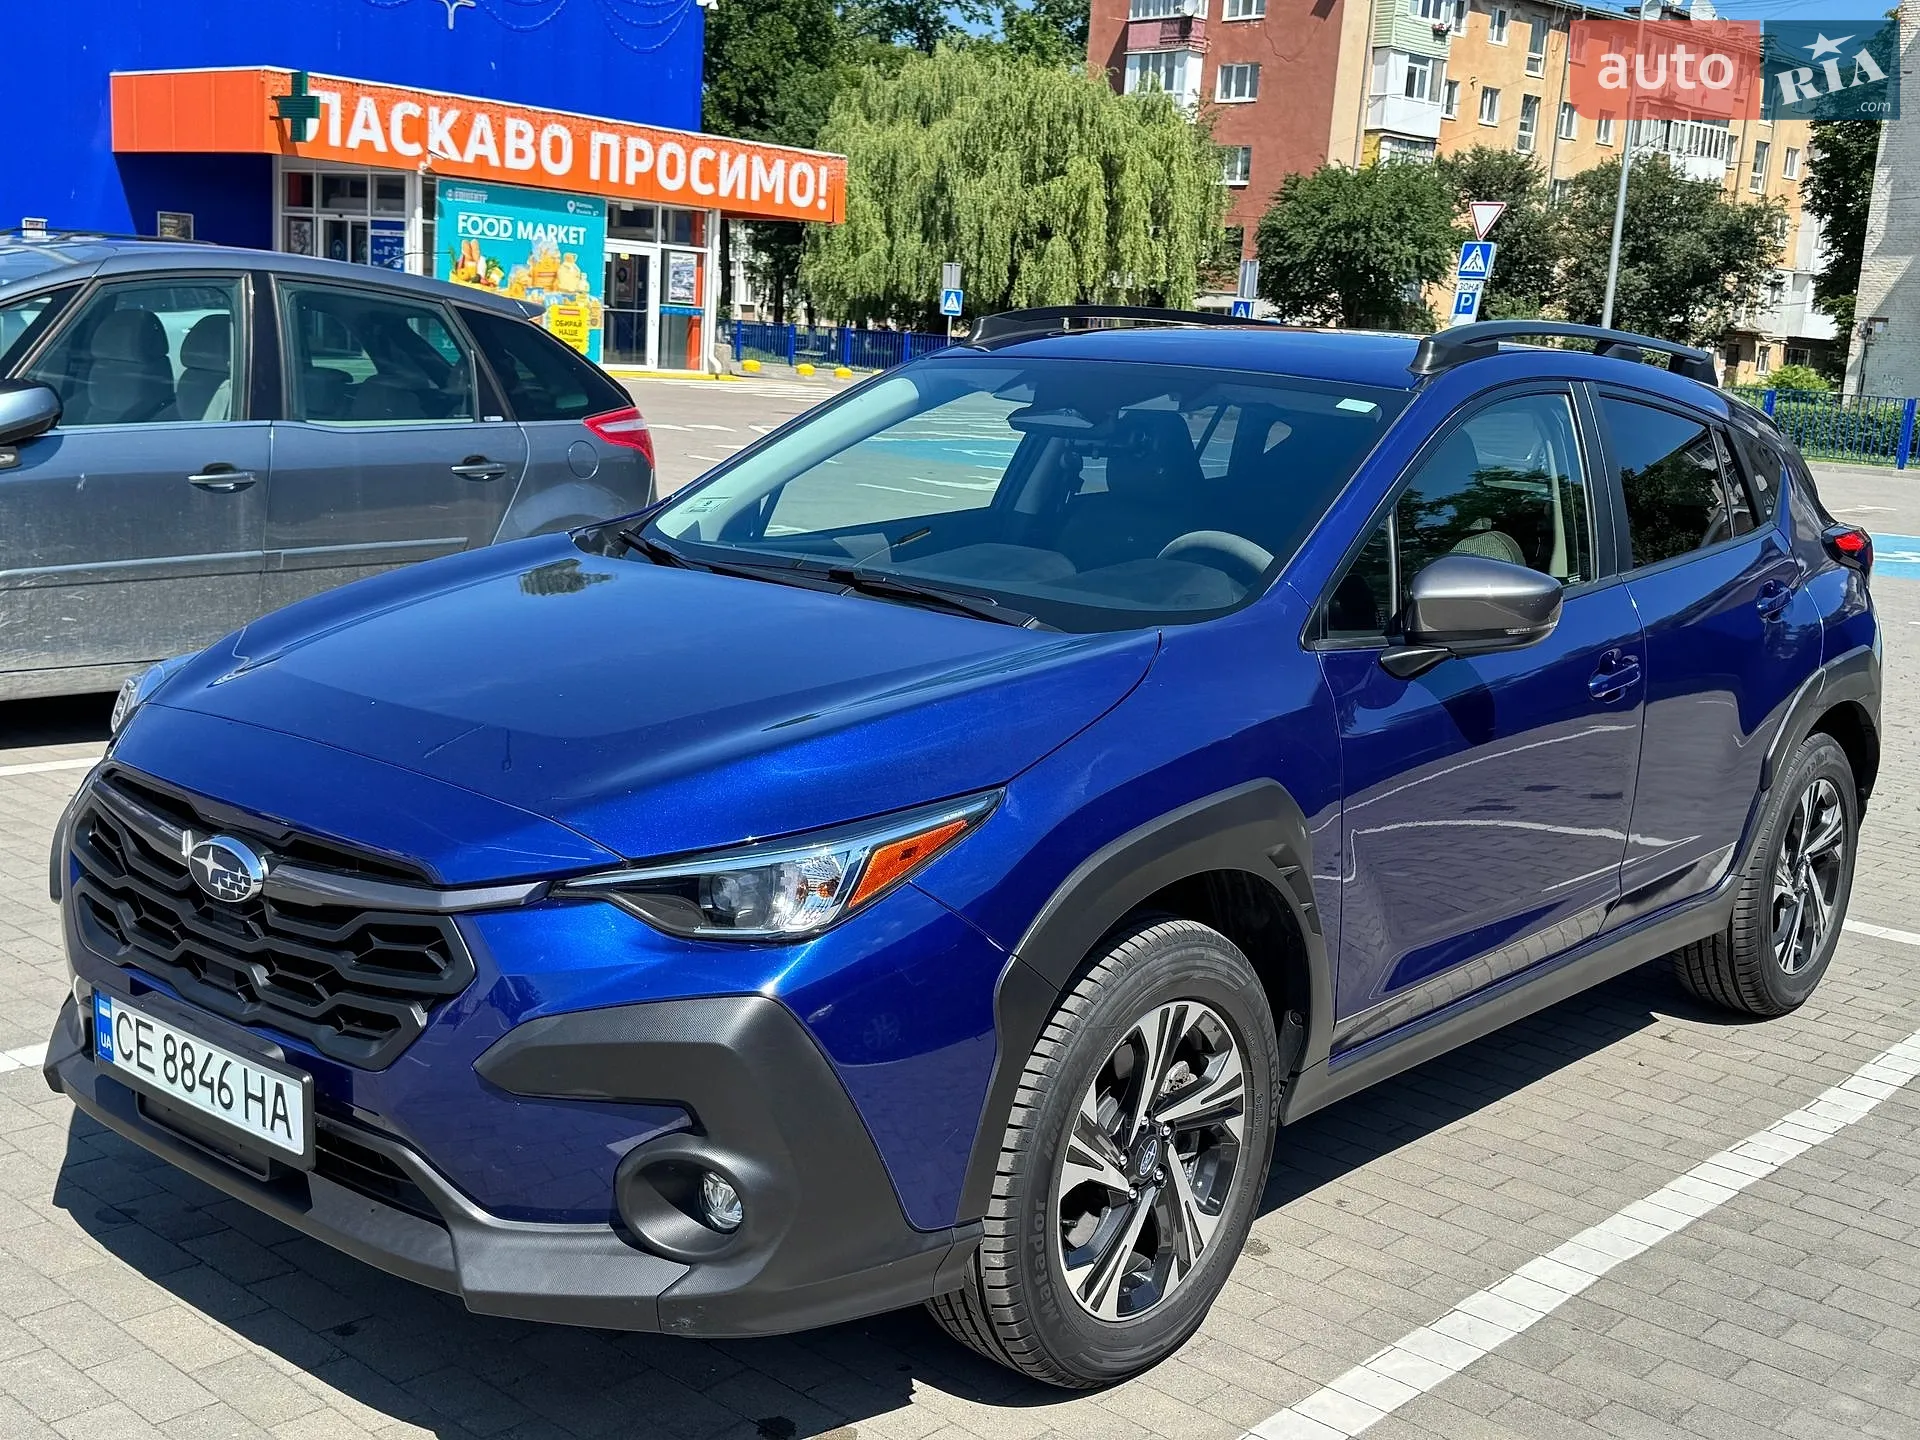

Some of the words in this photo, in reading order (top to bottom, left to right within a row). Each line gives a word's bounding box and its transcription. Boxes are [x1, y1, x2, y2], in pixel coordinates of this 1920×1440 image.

[305, 89, 573, 176] ЛАСКАВО
[589, 131, 828, 211] ПРОСИМО!
[458, 215, 513, 238] FOOD
[517, 221, 587, 245] MARKET
[1458, 282, 1480, 291] ЗОНА
[100, 1031, 112, 1052] UA
[115, 1011, 156, 1076] CE
[163, 1033, 234, 1110] 8846
[242, 1067, 293, 1141] HA
